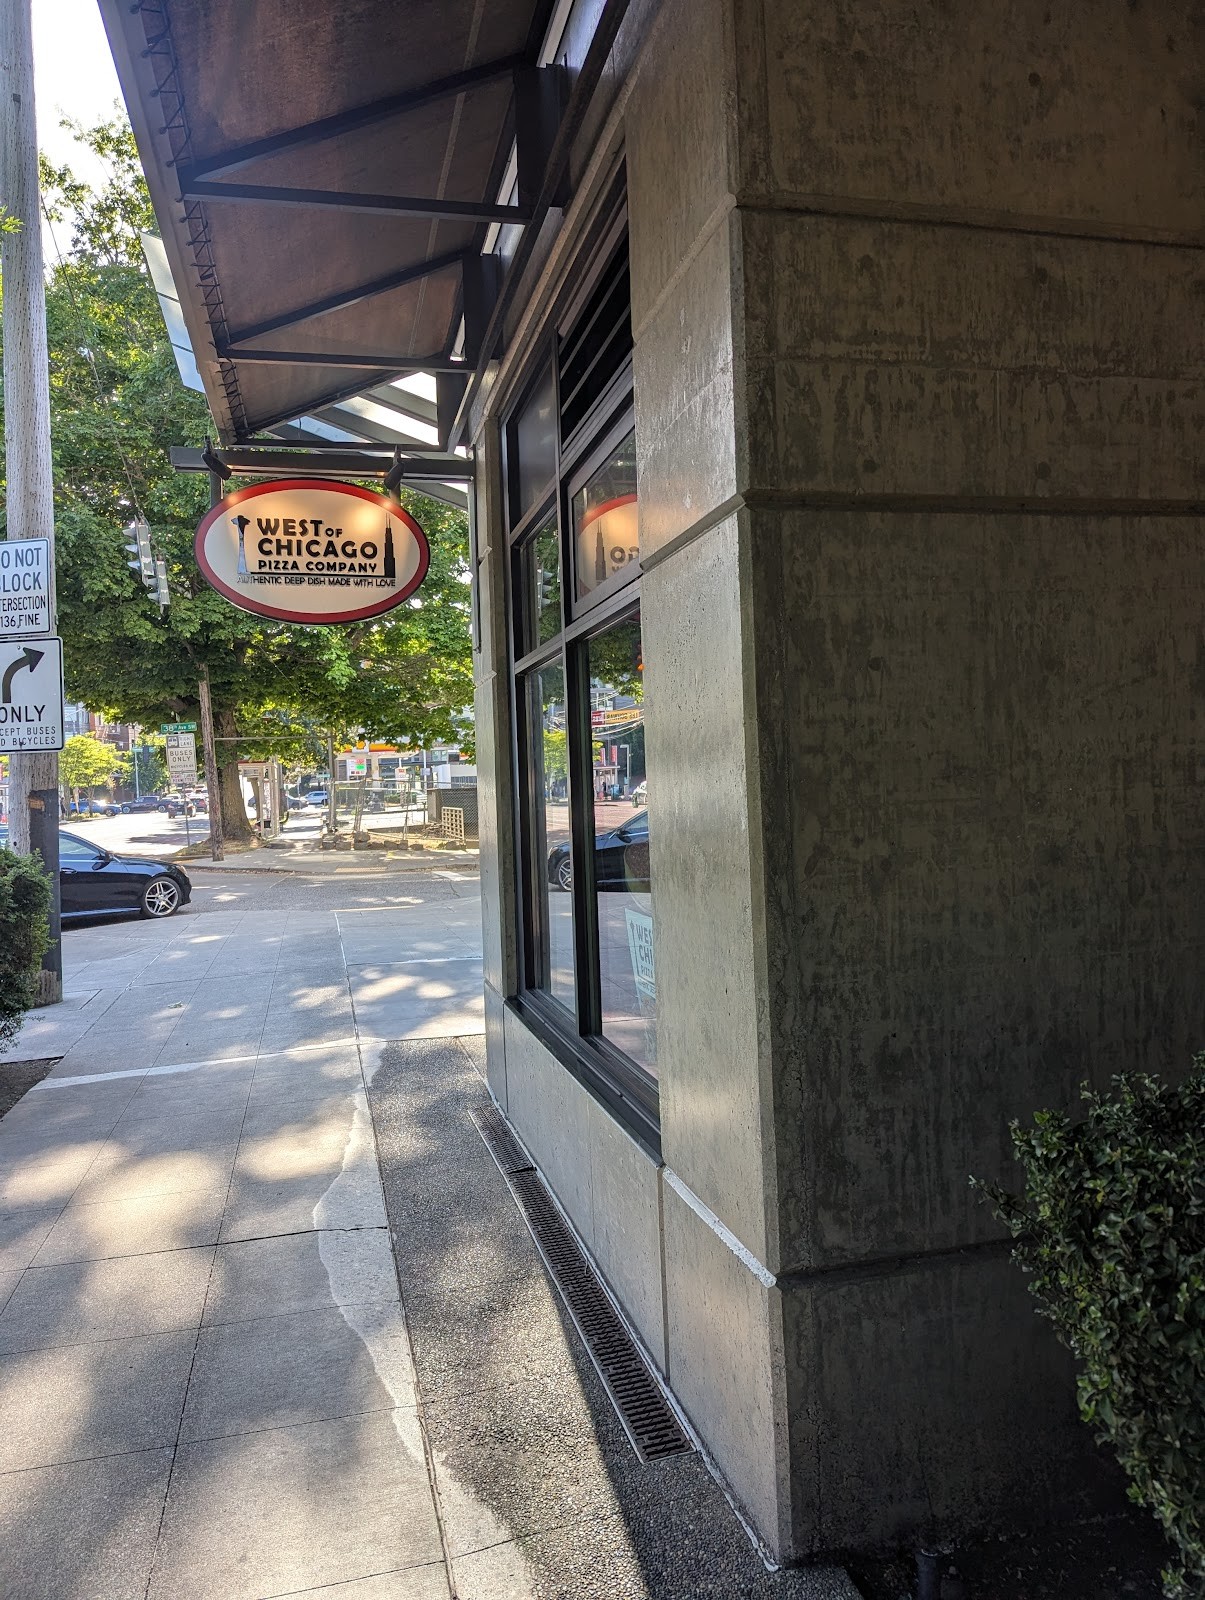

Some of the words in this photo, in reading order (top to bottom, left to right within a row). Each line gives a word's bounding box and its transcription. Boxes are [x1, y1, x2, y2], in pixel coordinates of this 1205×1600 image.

[256, 517, 323, 538] WEST
[325, 527, 343, 538] OF
[257, 538, 378, 560] CHICAGO
[1, 550, 10, 569] O
[15, 547, 42, 568] NOT
[258, 559, 299, 571] PIZZA
[305, 561, 377, 573] COMPANY
[0, 571, 42, 592] LOCK
[237, 575, 282, 586] AUTHENTIC
[284, 576, 305, 586] DEEP
[307, 577, 326, 587] DISH
[328, 577, 351, 588] MADE
[353, 578, 373, 588] WITH
[375, 579, 396, 589] LOVE
[0, 615, 16, 628] 136
[19, 613, 41, 627] FINE
[0, 704, 46, 723] ONLY
[0, 727, 21, 736] CEPT
[27, 726, 56, 736] BUSES
[12, 736, 56, 746] BICYCLES
[170, 749, 193, 757] BUSES
